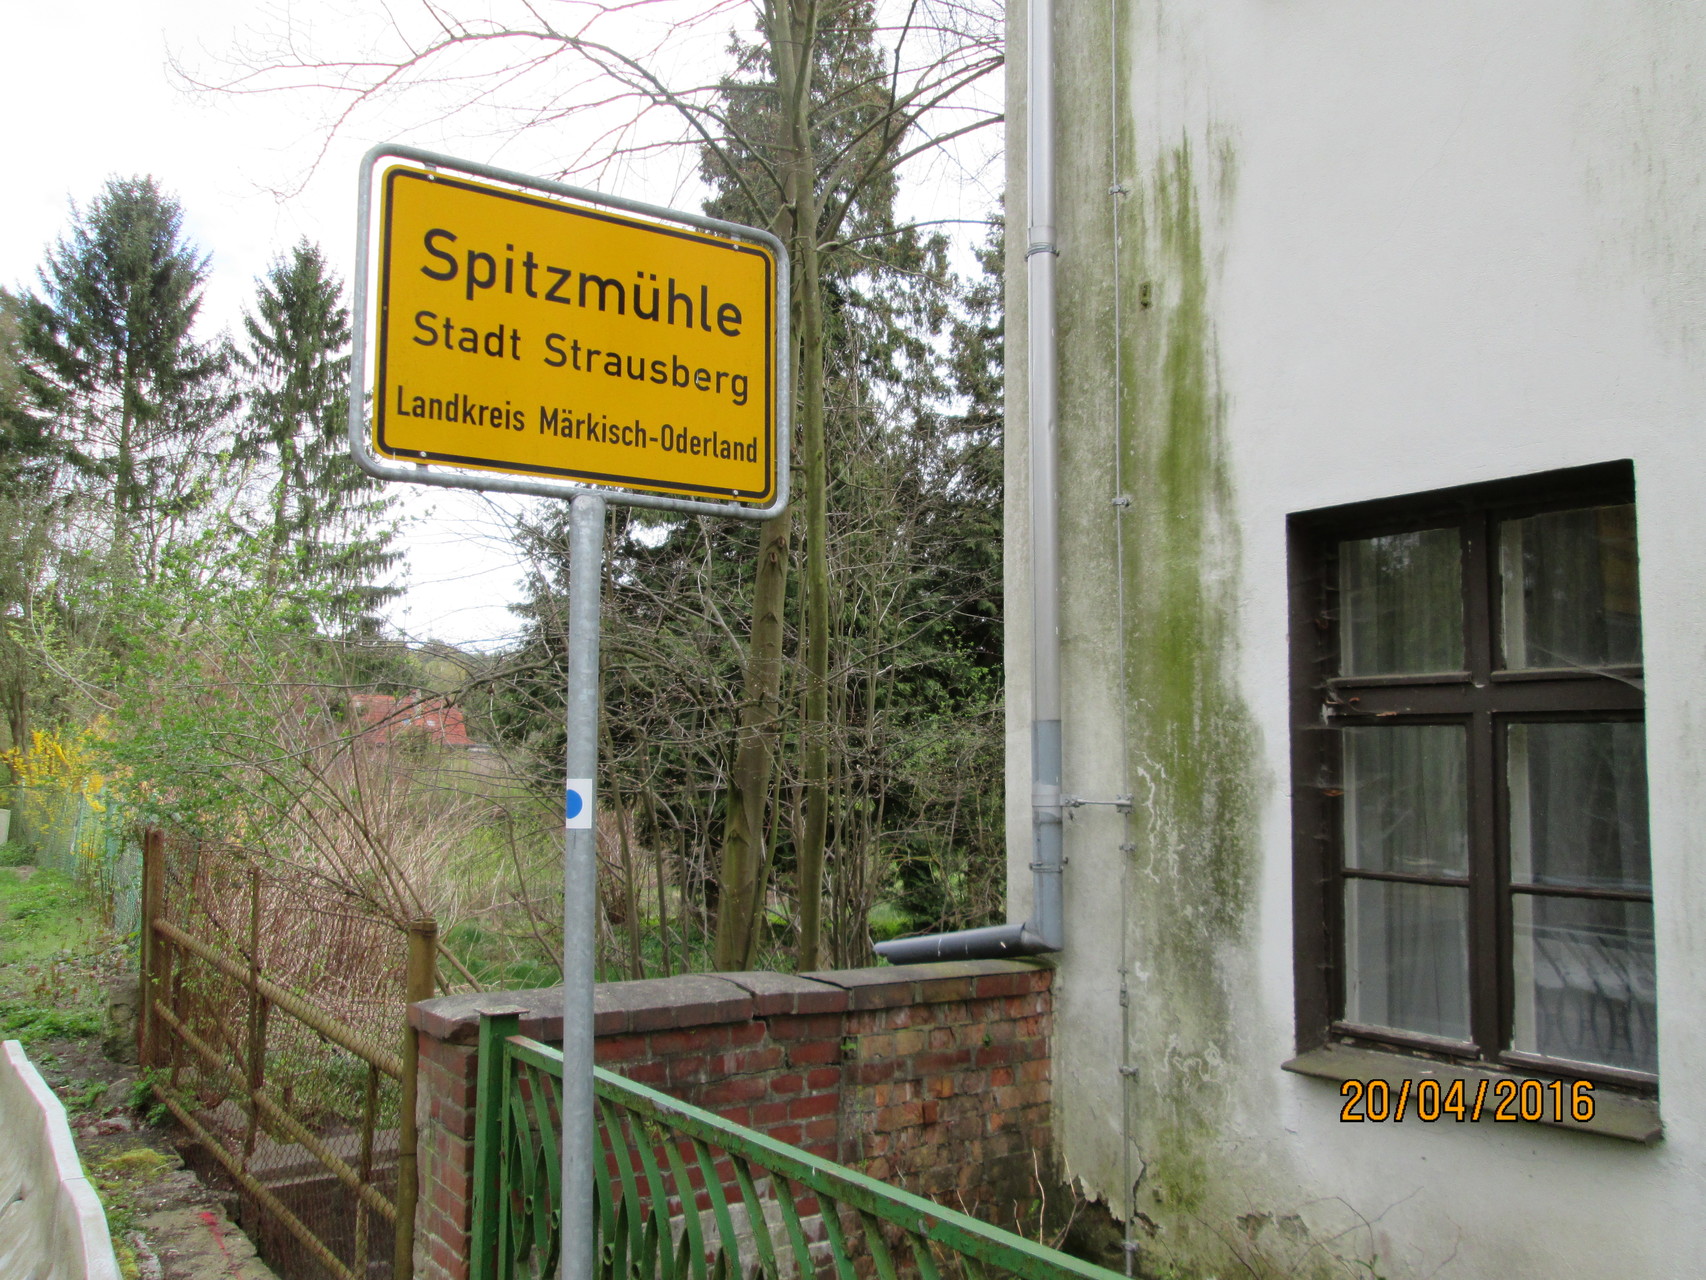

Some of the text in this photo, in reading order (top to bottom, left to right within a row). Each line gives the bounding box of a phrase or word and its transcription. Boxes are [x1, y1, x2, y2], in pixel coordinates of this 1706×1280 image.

[420, 228, 742, 337] Spitzmühle
[412, 309, 749, 406] Stadt Strausberg
[396, 385, 758, 463] Landkreis Märkisch-Oderland
